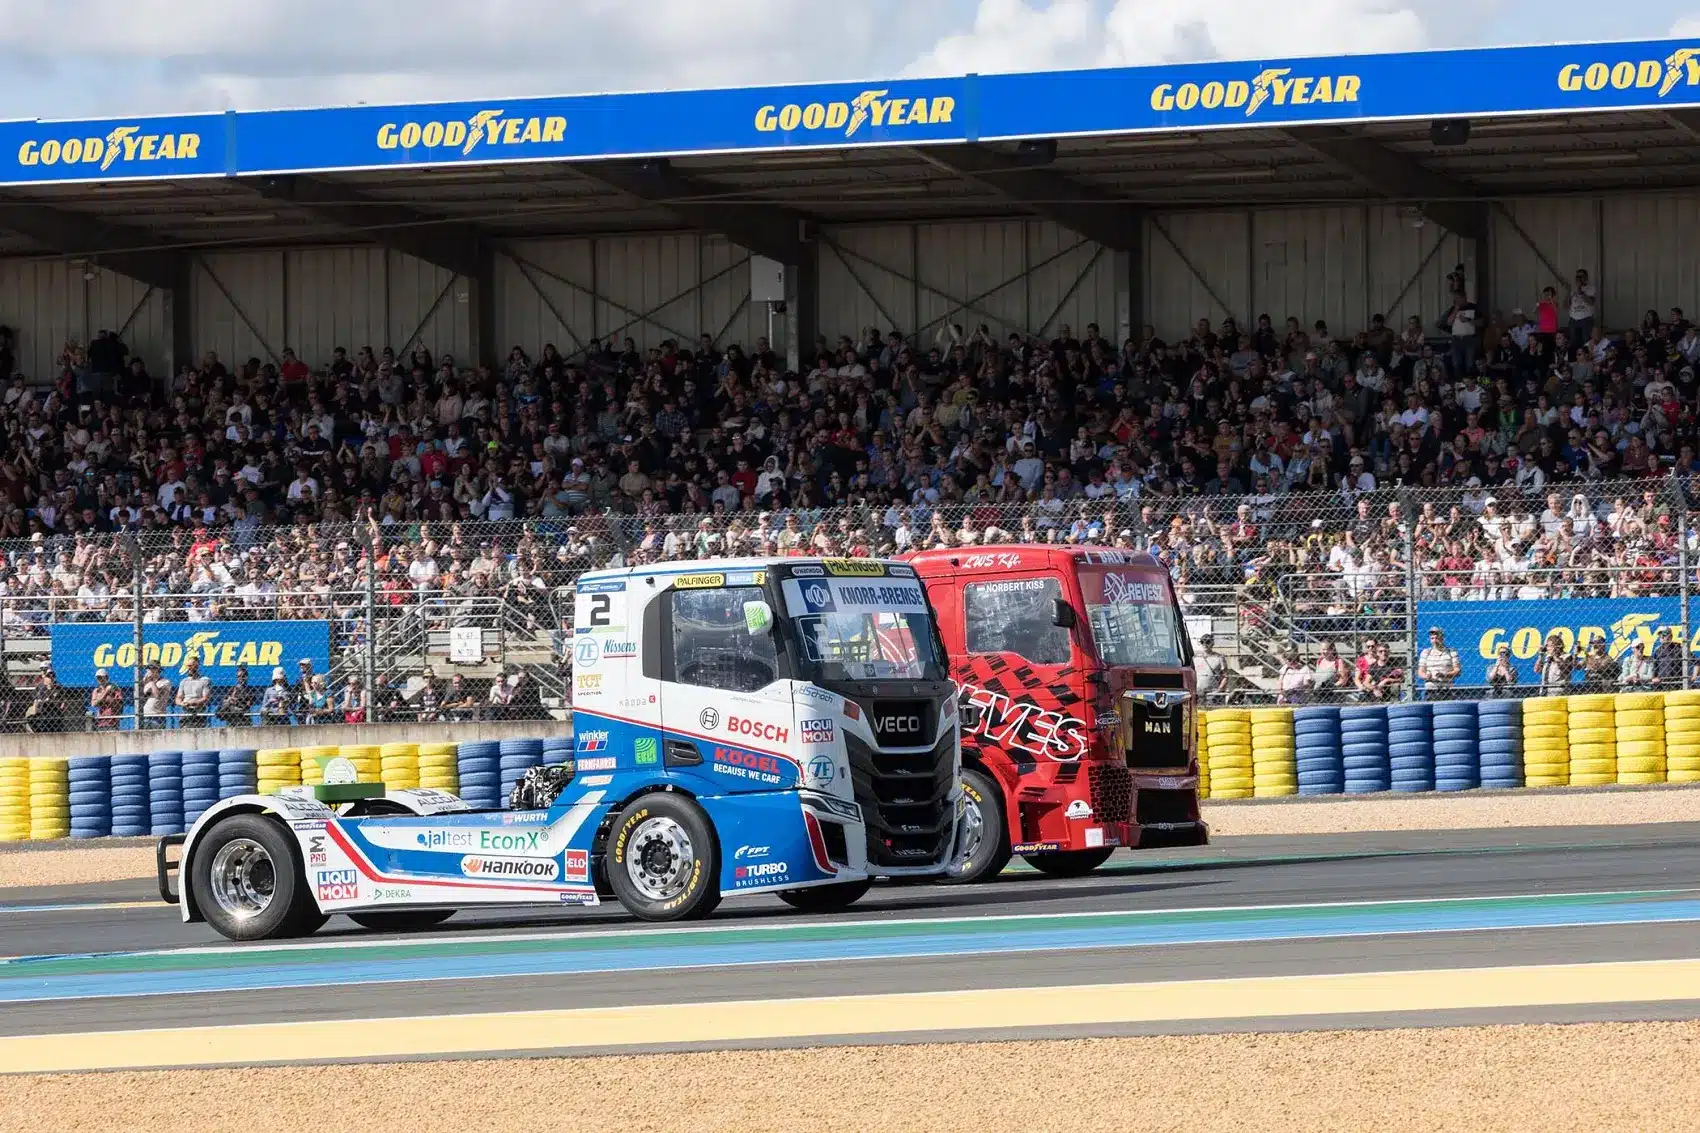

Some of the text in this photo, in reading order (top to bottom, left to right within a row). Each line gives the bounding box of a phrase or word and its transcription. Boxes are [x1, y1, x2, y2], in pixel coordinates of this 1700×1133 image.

[1150, 68, 1361, 117] GOODYEAR
[754, 89, 955, 137] GOODYEAR
[376, 109, 568, 155] GOODYEAR
[18, 126, 201, 170] GOODYEAR
[677, 576, 721, 585] PALFINGER
[986, 580, 1044, 592] NORBERT KISS
[839, 587, 922, 606] KNORR-BREMSE
[590, 594, 610, 625] 2
[93, 635, 282, 671] GOODYEAR
[603, 639, 636, 653] Nissens
[728, 717, 789, 743] BOSCH
[802, 720, 832, 731] LIQUI
[873, 716, 920, 733] VECO
[1145, 721, 1171, 733] MAN
[578, 730, 609, 741] winkler
[802, 731, 833, 743] MOLY
[713, 763, 781, 784] BECAUSE WE CARE
[429, 830, 472, 848] jaltest
[615, 808, 649, 864] GOODYEAR
[1014, 843, 1057, 852] GOODYEAR
[319, 871, 356, 884] LIQUI
[735, 875, 789, 887] BRUSHLESS
[320, 885, 357, 899] MOLY
[385, 890, 412, 898] DEKRA
